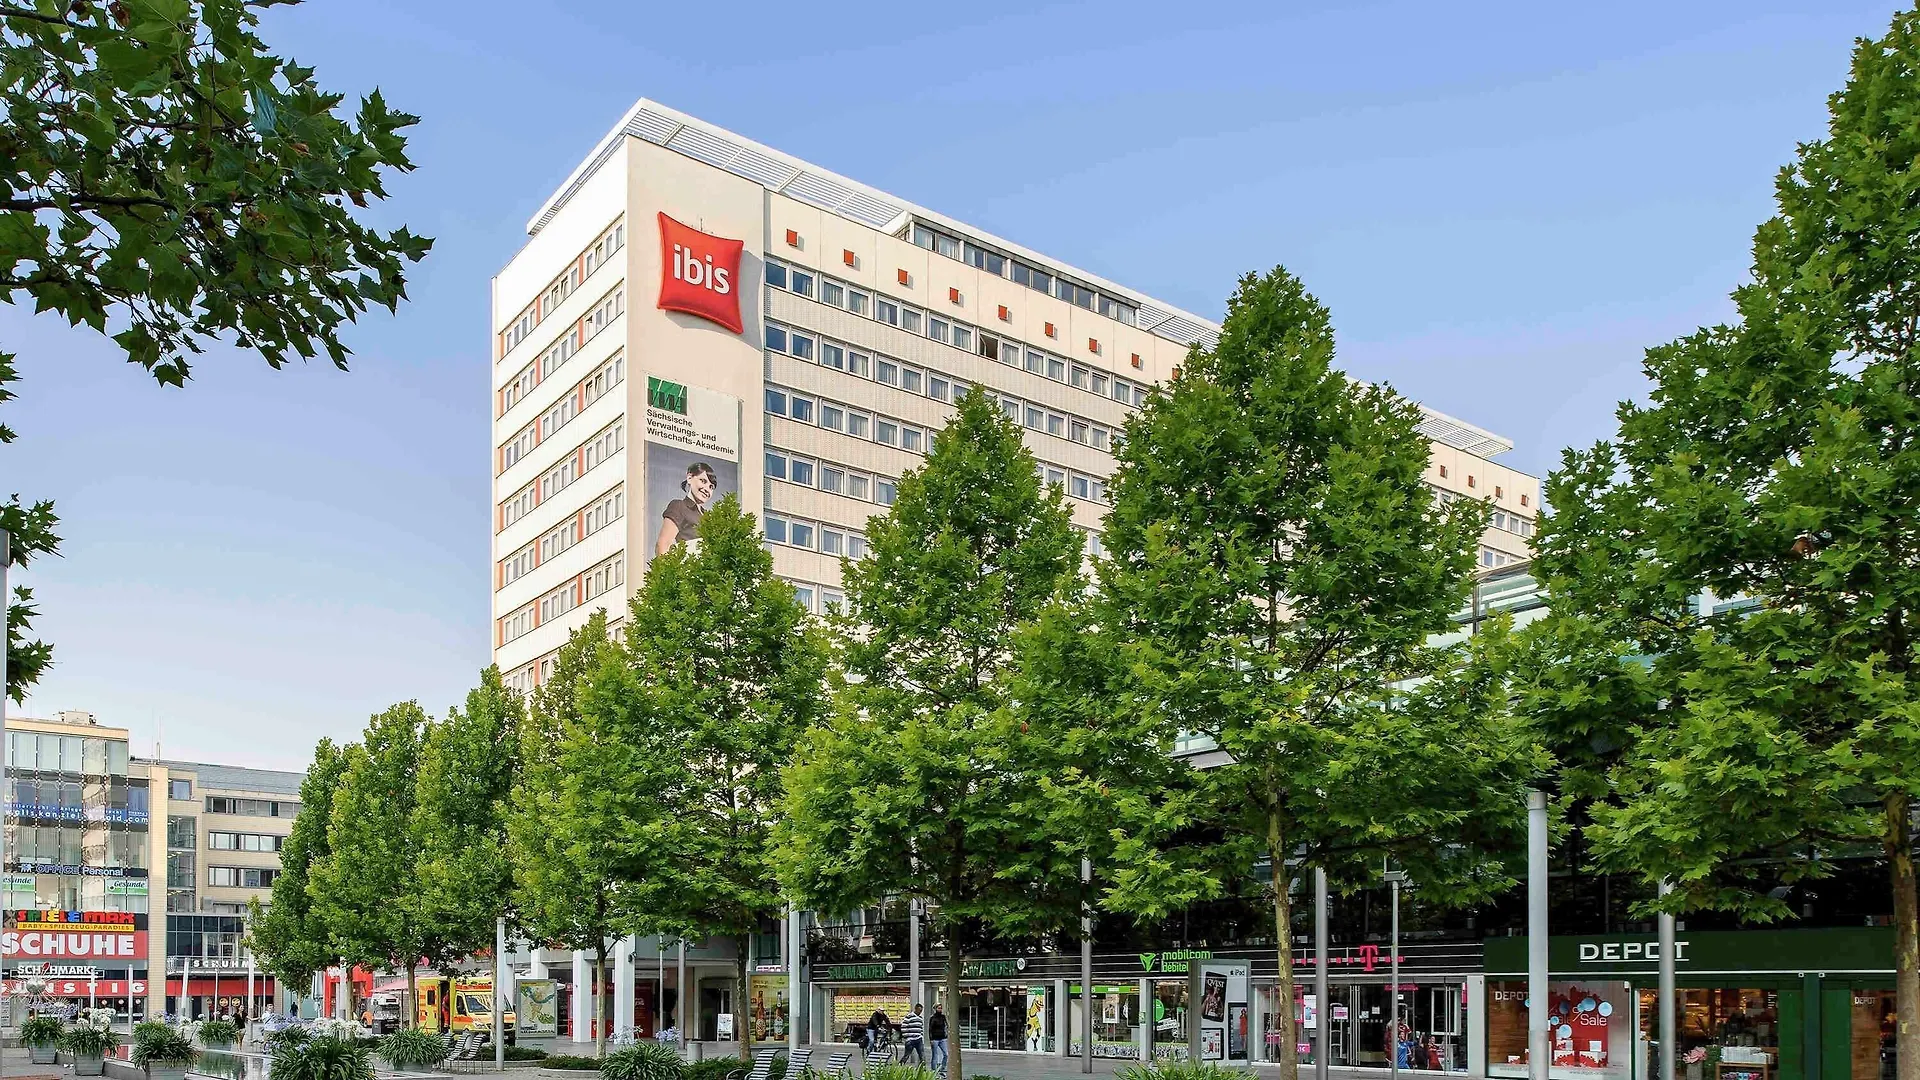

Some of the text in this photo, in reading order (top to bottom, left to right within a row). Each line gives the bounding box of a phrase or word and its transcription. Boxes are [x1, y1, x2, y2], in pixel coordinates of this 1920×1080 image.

[673, 243, 730, 294] ibis
[646, 408, 693, 428] Sächsische
[647, 418, 717, 442] Verwaltungs- und
[647, 427, 735, 455] Wirtschafts-Akademie
[82, 866, 123, 876] Personal
[2, 876, 32, 885] esunde
[113, 880, 146, 889] Gesunde
[17, 908, 80, 922] SPIELE
[2, 932, 135, 956] SCHUHE
[1580, 942, 1690, 960] DEPOT
[1161, 950, 1211, 960] mobilcom
[828, 964, 888, 979] SALAMANDER
[1854, 996, 1876, 1005] DEPOT
[1580, 1013, 1607, 1026] Sale
